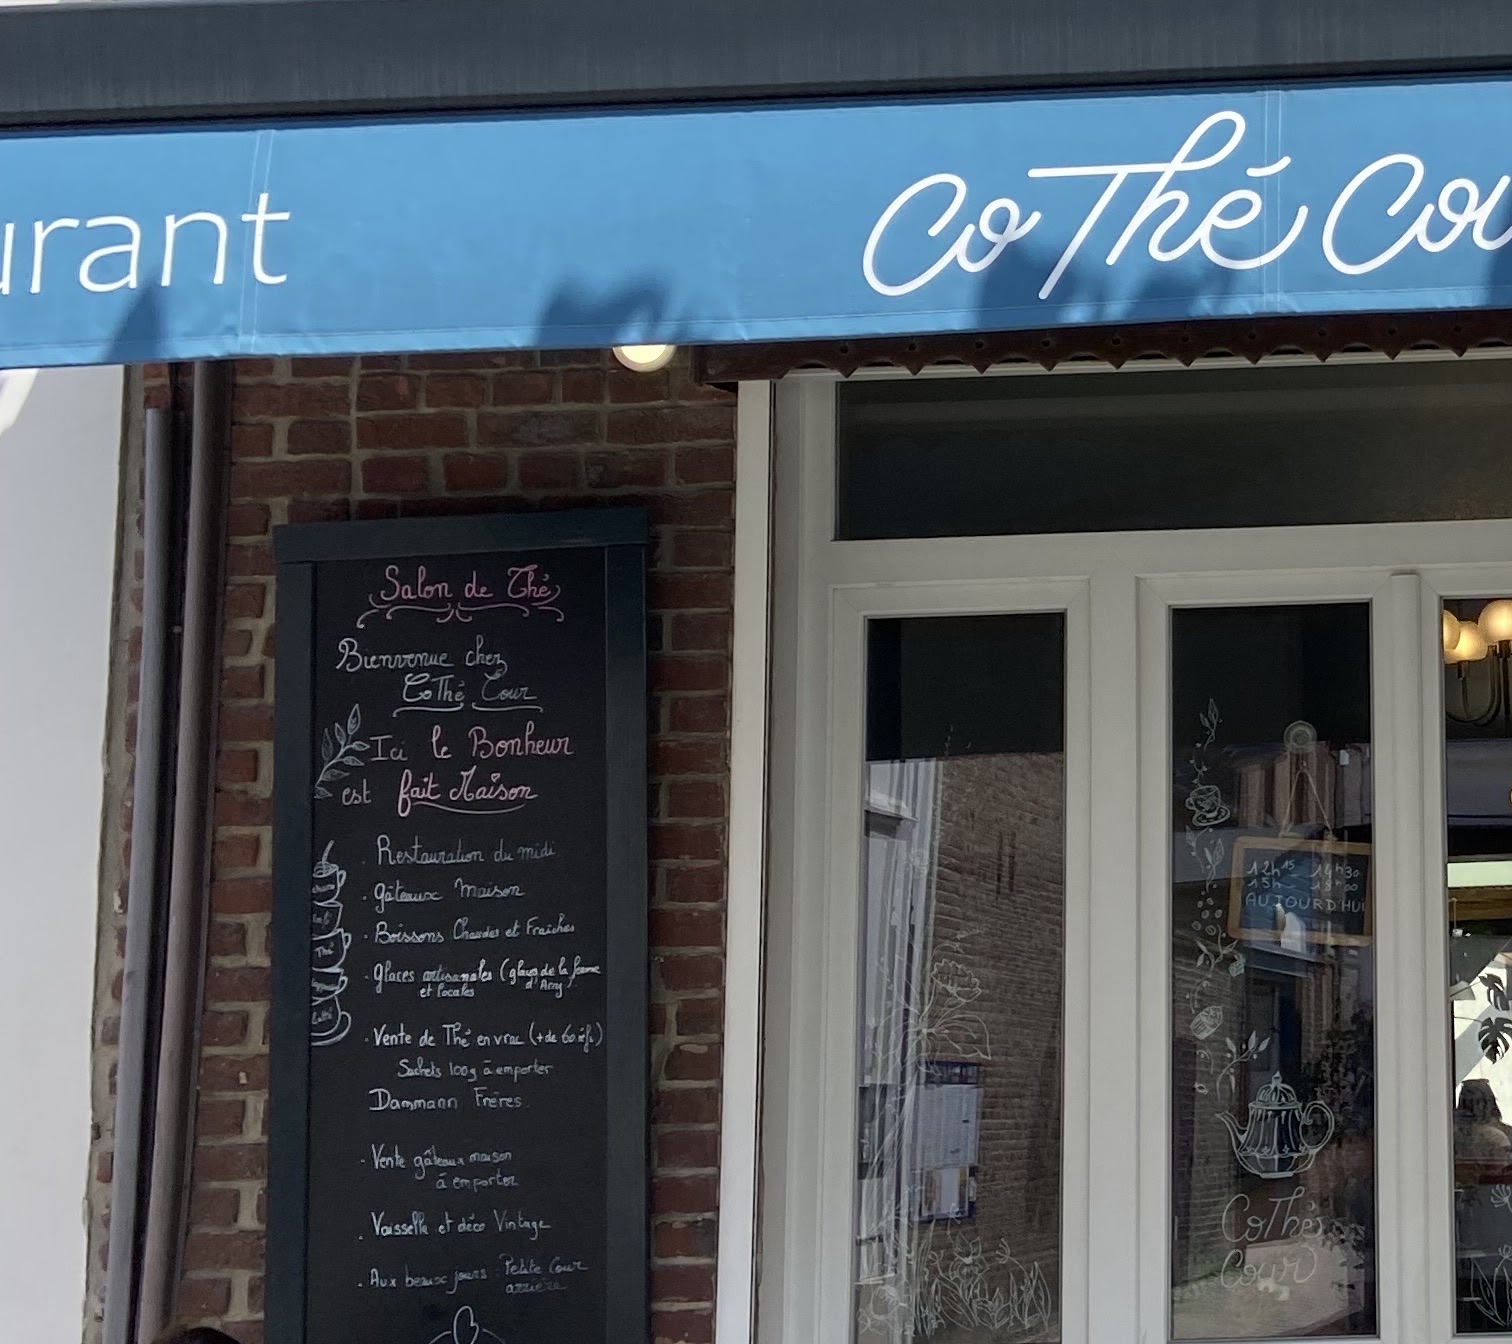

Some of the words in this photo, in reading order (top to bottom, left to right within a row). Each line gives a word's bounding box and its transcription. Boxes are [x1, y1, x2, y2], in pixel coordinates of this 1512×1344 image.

[0, 192, 290, 296] rant
[380, 565, 453, 602] Salon
[464, 570, 493, 598] de
[506, 564, 557, 600] Thé
[336, 637, 454, 672] Bienvenue
[465, 634, 508, 677] chez
[481, 670, 538, 702] Cour
[369, 735, 408, 761] Ici
[431, 724, 452, 759] le
[467, 720, 574, 759] Bonheur
[341, 778, 372, 806] est
[397, 769, 441, 817] fait
[449, 765, 538, 801] Maison
[376, 834, 485, 866] Restauration
[493, 838, 514, 862] du
[517, 840, 556, 861] midi
[374, 920, 445, 944] Boissons
[452, 916, 500, 941] Chaudes
[504, 919, 521, 938] et
[421, 958, 493, 983] artisanales
[540, 962, 556, 977] de
[558, 956, 569, 976] la
[419, 985, 433, 998] et
[436, 981, 476, 998] locales
[372, 1022, 413, 1047] Vente
[418, 1028, 437, 1048] de
[441, 1021, 472, 1049] Thé
[476, 1033, 491, 1046] en
[493, 1030, 525, 1046] vrac
[397, 1058, 442, 1079] Sachets
[448, 1062, 477, 1083] 100g
[482, 1060, 493, 1077] à
[494, 1058, 554, 1083] emporter
[368, 1087, 459, 1112] Dammann
[473, 1086, 524, 1109] Frères
[370, 1143, 407, 1170] Vente
[412, 1145, 466, 1181] gâteaux
[469, 1150, 513, 1164] maison
[434, 1172, 448, 1190] à
[452, 1170, 520, 1193] emporter
[370, 1210, 430, 1238] Vaisselle
[437, 1211, 454, 1235] et
[456, 1212, 487, 1234] déco
[492, 1208, 553, 1242] Vintage
[369, 1267, 397, 1289] Aux
[404, 1263, 449, 1290] beaux
[446, 1267, 489, 1296] jours
[499, 1253, 543, 1277] Petite
[547, 1255, 591, 1276] Cour
[1220, 1244, 1319, 1289] Cour
